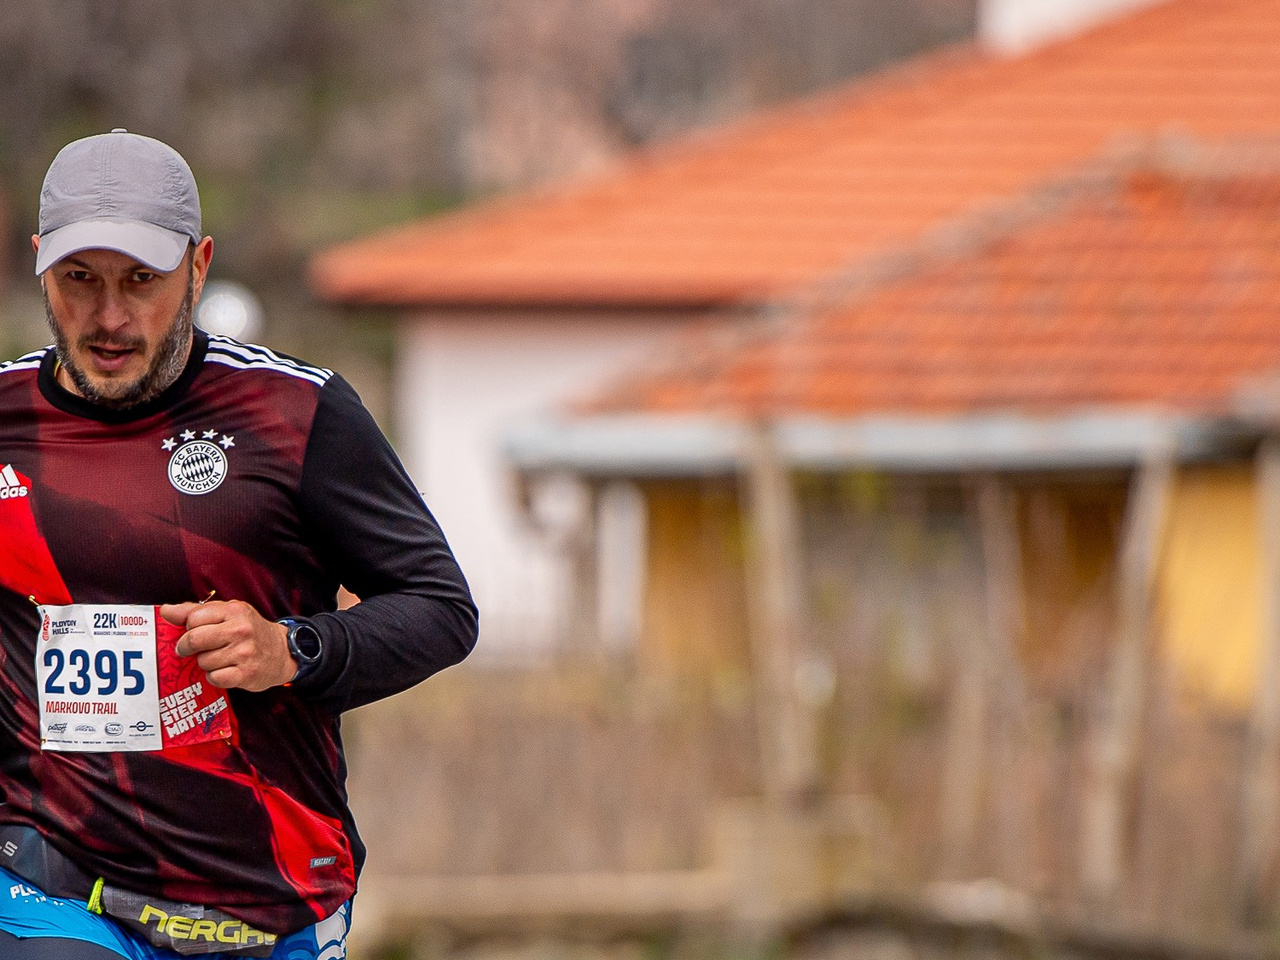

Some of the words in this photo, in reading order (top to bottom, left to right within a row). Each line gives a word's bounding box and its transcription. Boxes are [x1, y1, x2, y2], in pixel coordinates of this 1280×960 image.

[174, 453, 186, 466] FC
[185, 445, 222, 464] BAYERN
[52, 627, 70, 636] HILLS
[93, 612, 117, 629] 22K
[120, 616, 148, 626] 1000D+
[43, 648, 145, 696] 2395
[45, 701, 91, 714] MARKOVO
[92, 702, 119, 715] TRAIL
[159, 681, 203, 713] EVERY
[160, 699, 198, 726] STEP
[165, 696, 228, 739] MATTERS
